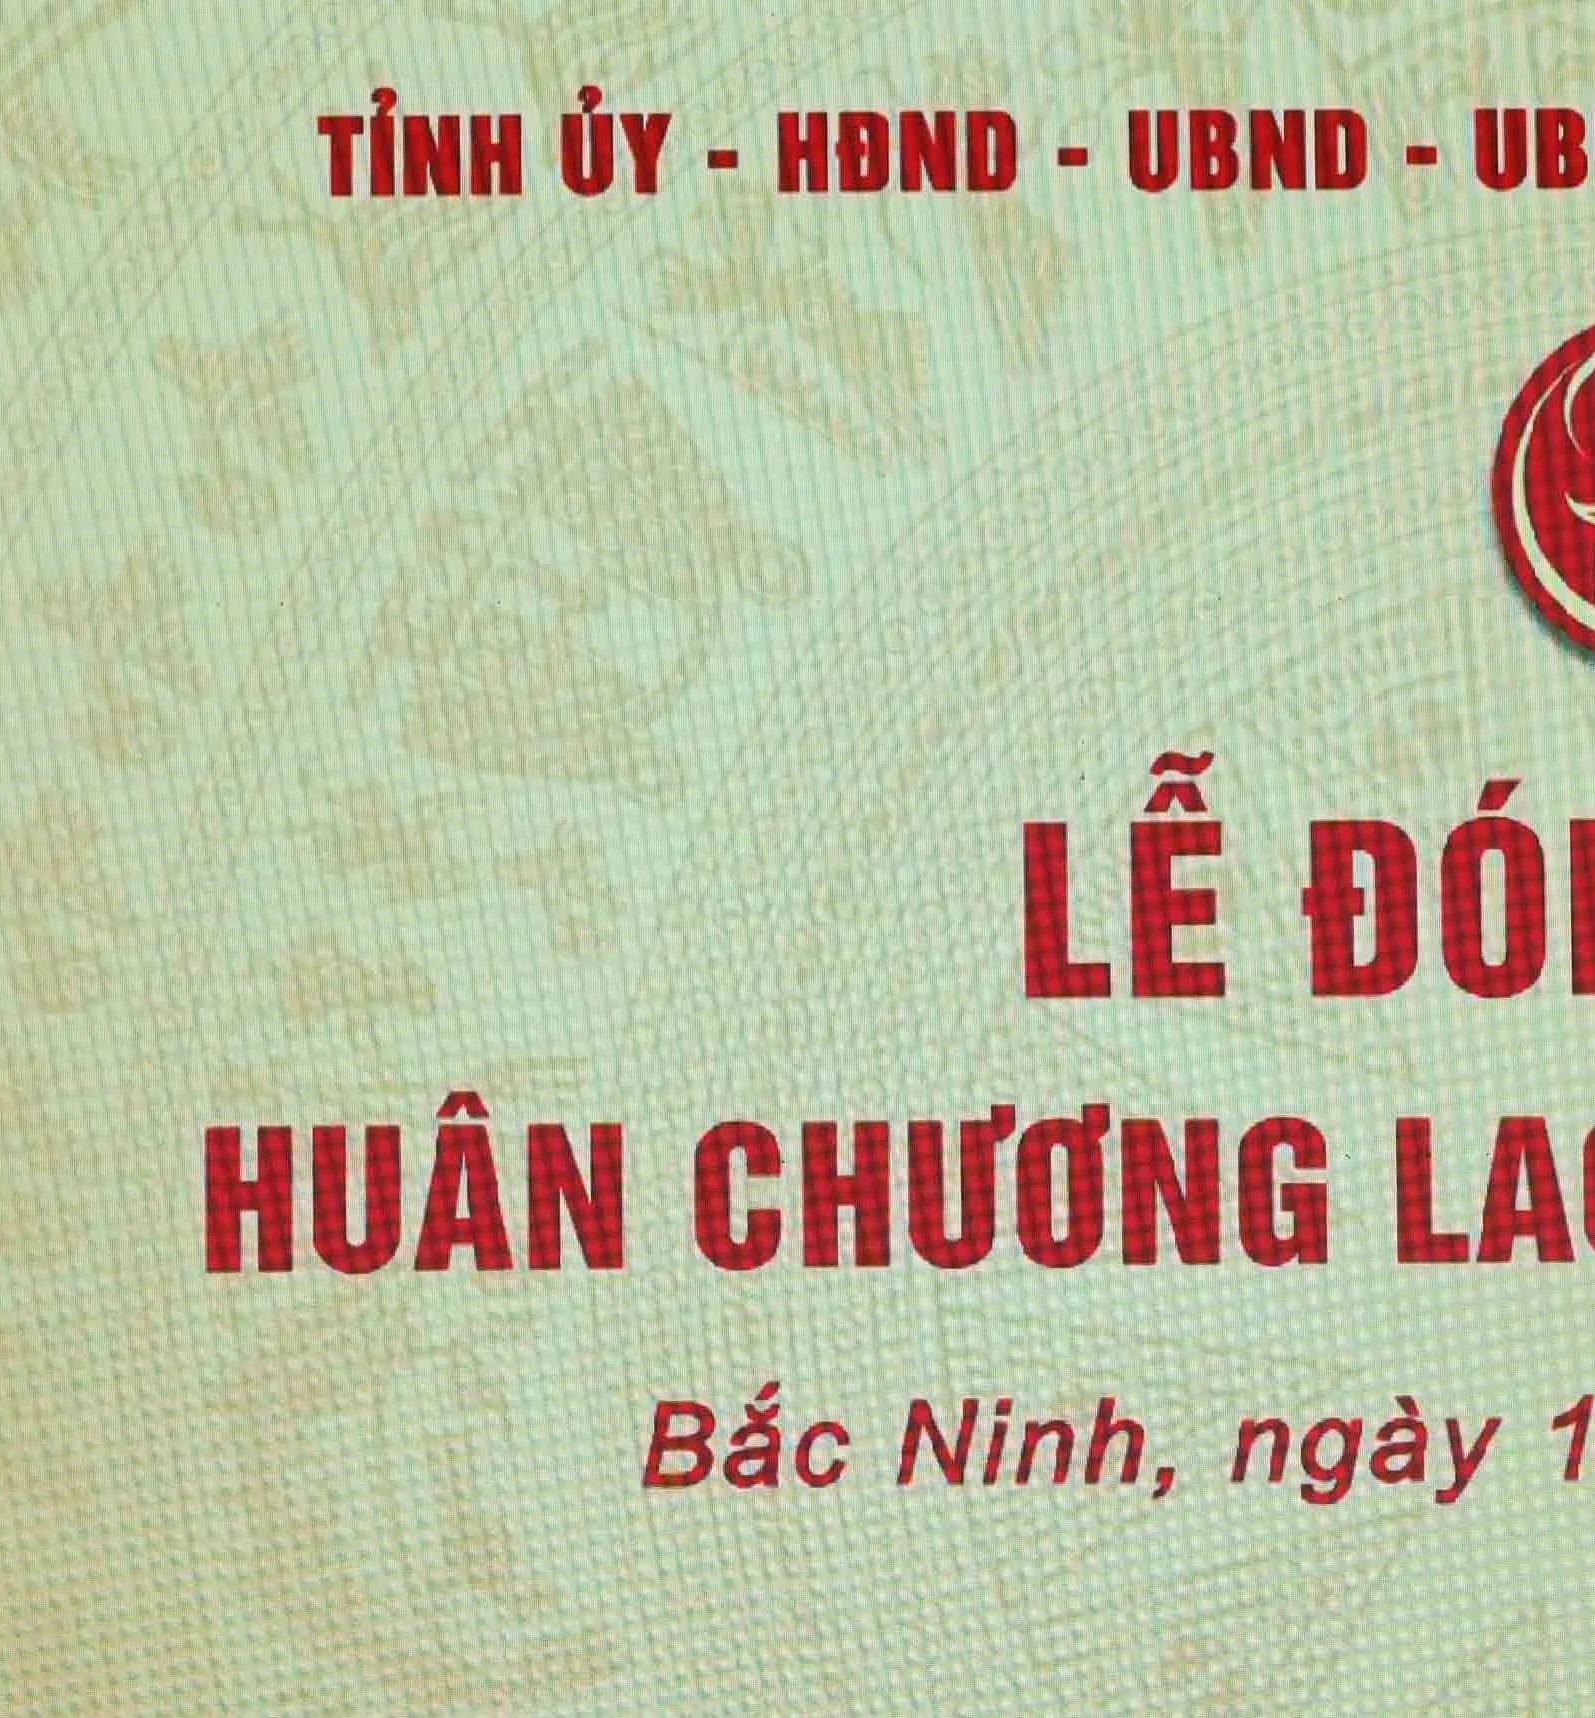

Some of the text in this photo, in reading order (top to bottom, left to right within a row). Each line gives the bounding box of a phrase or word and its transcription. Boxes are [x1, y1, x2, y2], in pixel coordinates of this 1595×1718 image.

[317, 86, 523, 197] TỈNH
[561, 84, 671, 197] ỦY
[709, 150, 738, 169] -
[777, 110, 1018, 193] HĐND
[1057, 147, 1089, 167] -
[1128, 108, 1369, 193] UBND
[1406, 145, 1438, 165] -
[1022, 751, 1227, 999] LỄ
[205, 1090, 624, 1276] HUÂN
[693, 1102, 1329, 1271] CHƯƠNG
[642, 1383, 849, 1490] Bắc
[896, 1397, 1176, 1497] Ninh,
[1230, 1395, 1500, 1505] ngày
